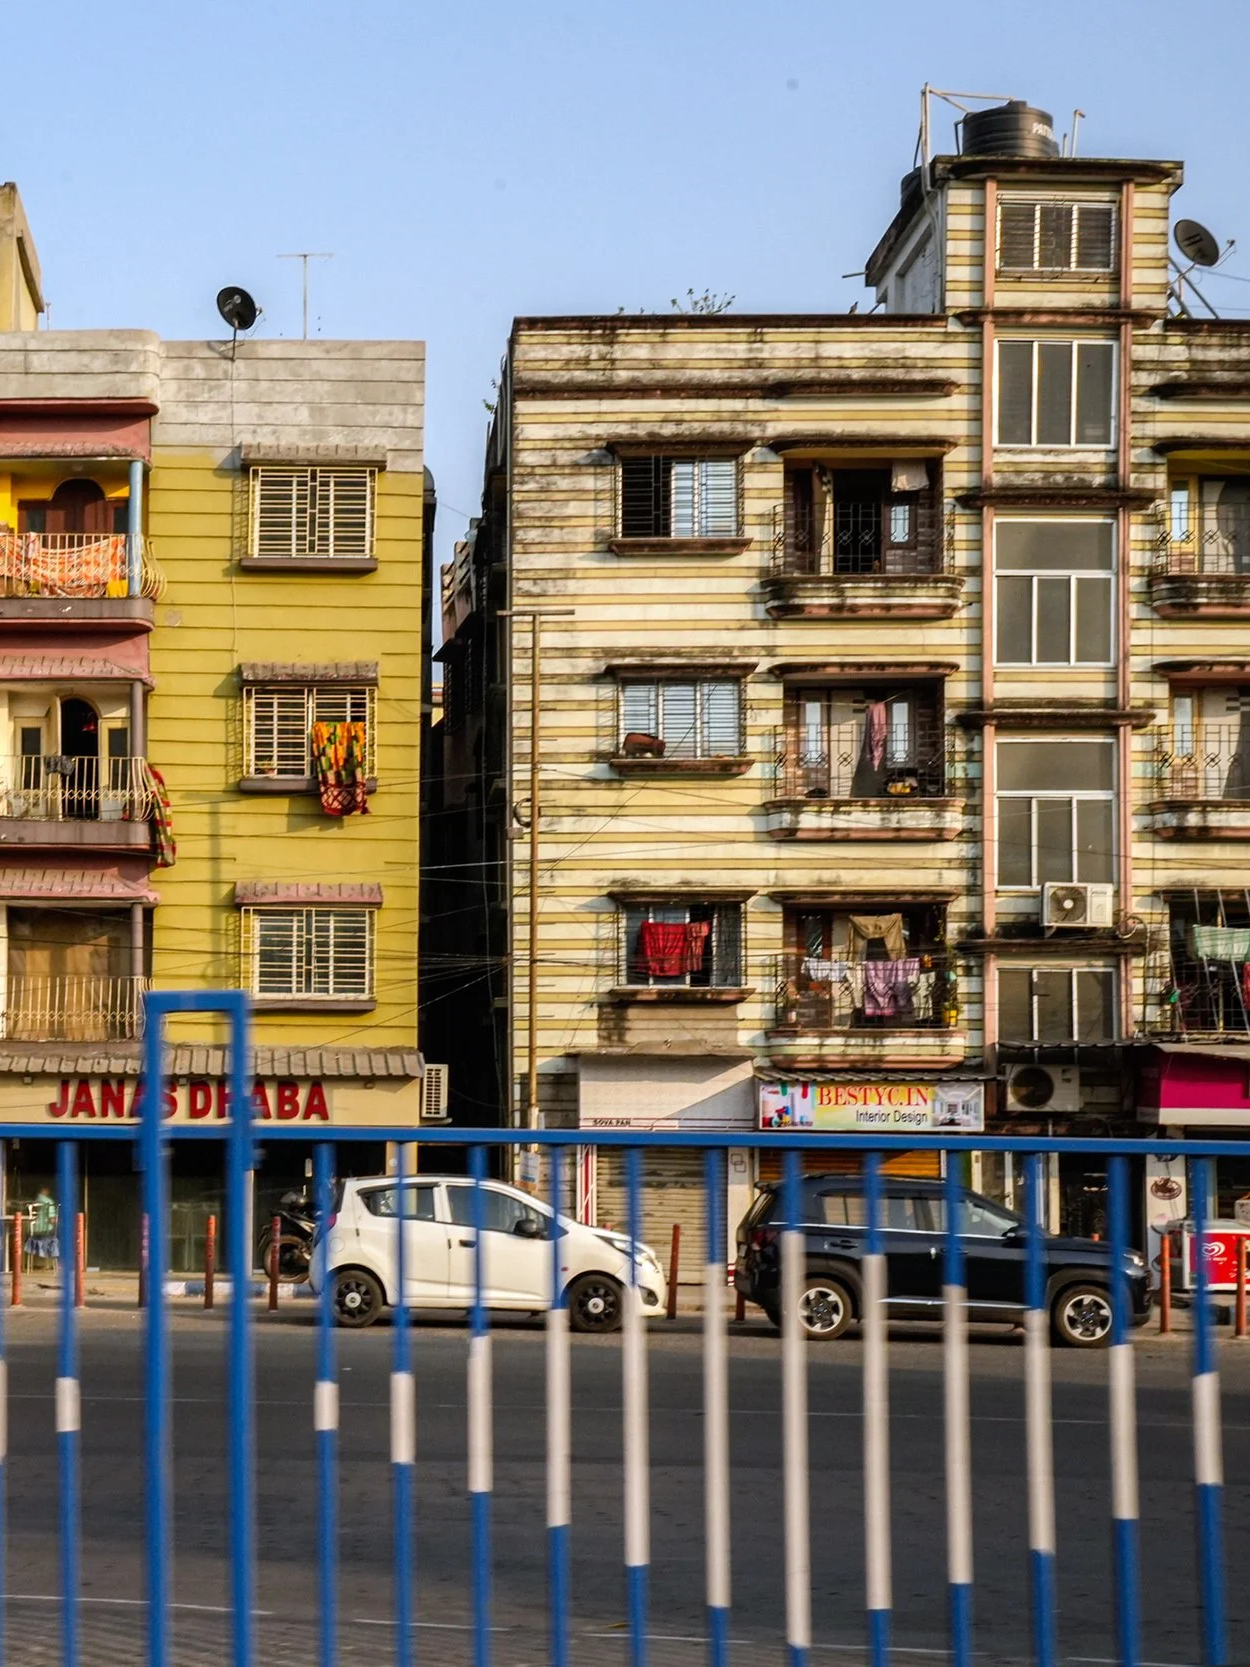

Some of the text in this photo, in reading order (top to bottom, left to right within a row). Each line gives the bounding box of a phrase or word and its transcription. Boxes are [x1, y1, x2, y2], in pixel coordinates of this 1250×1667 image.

[818, 1086, 930, 1107] BESTYC.IN
[856, 1109, 928, 1126] Interior Design
